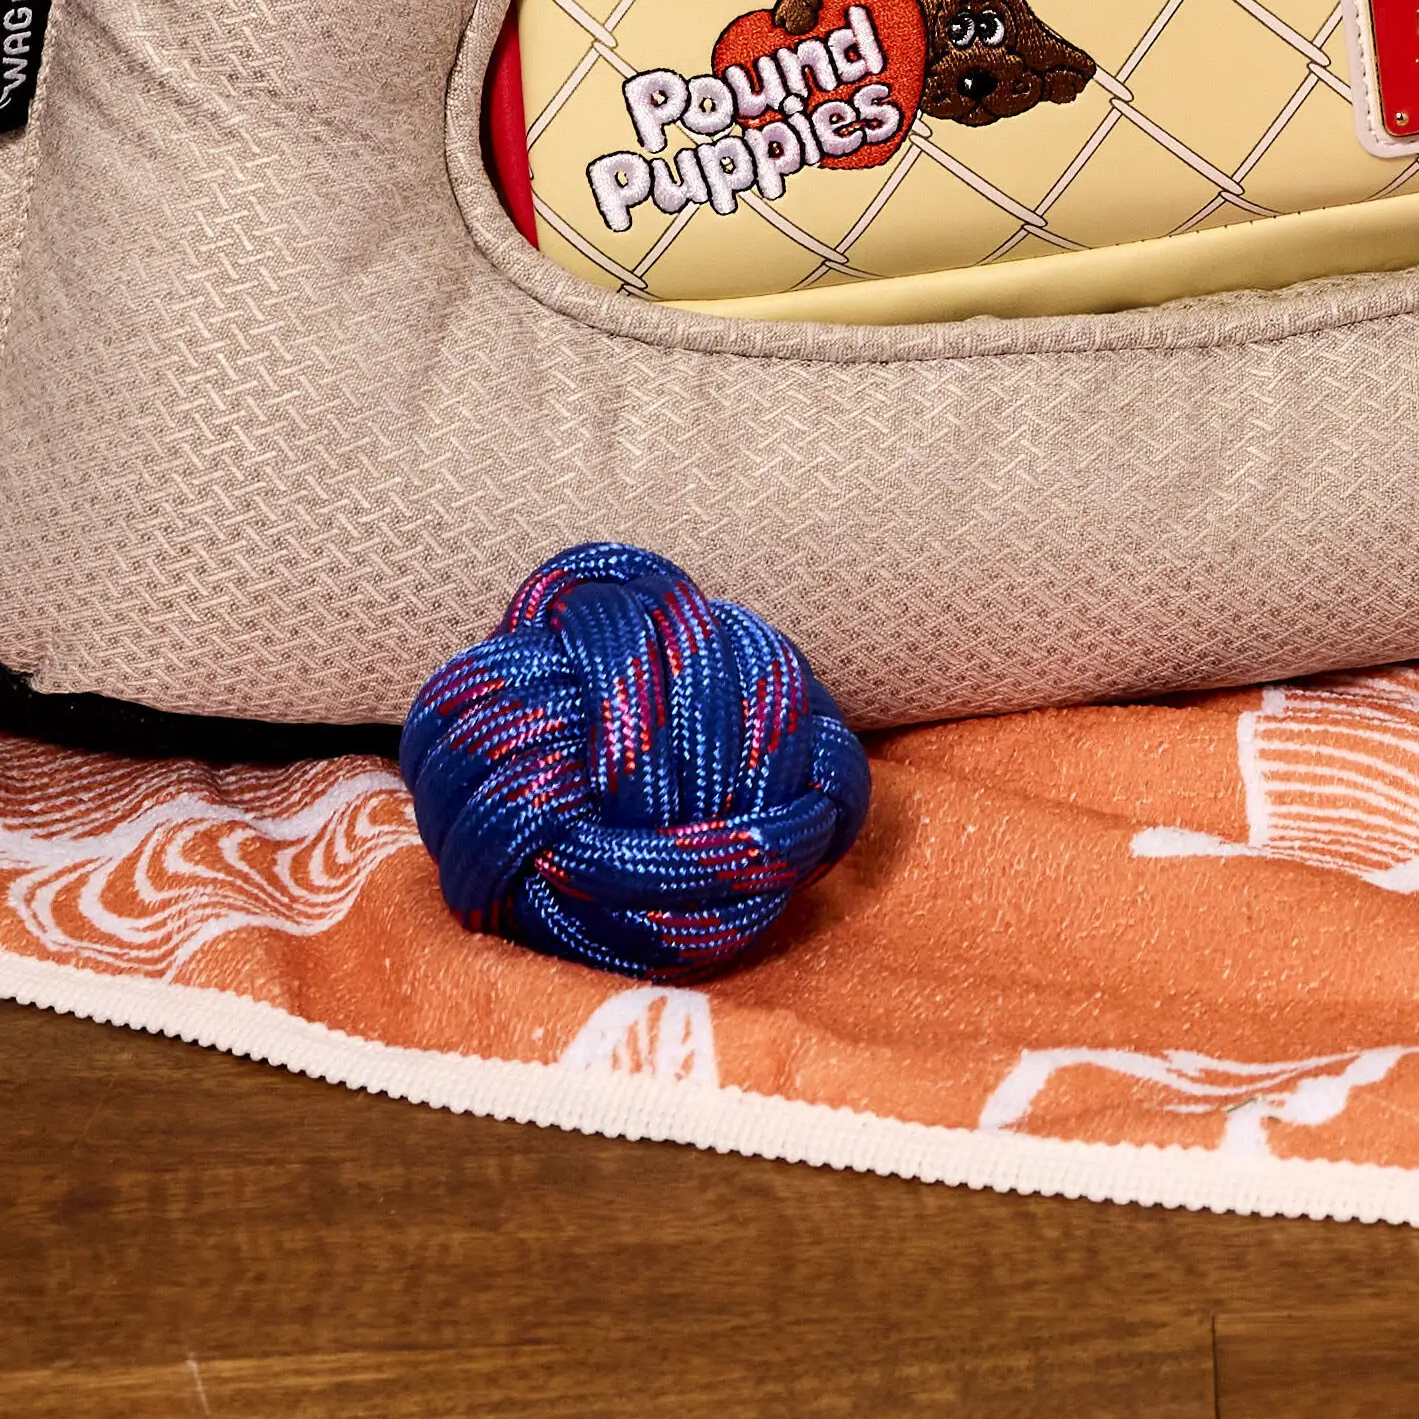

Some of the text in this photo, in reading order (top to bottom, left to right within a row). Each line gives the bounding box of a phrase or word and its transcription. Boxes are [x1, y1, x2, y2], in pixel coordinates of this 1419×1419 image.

[0, 7, 33, 95] WAG
[622, 4, 887, 153] Pound
[587, 83, 901, 232] Puppies
